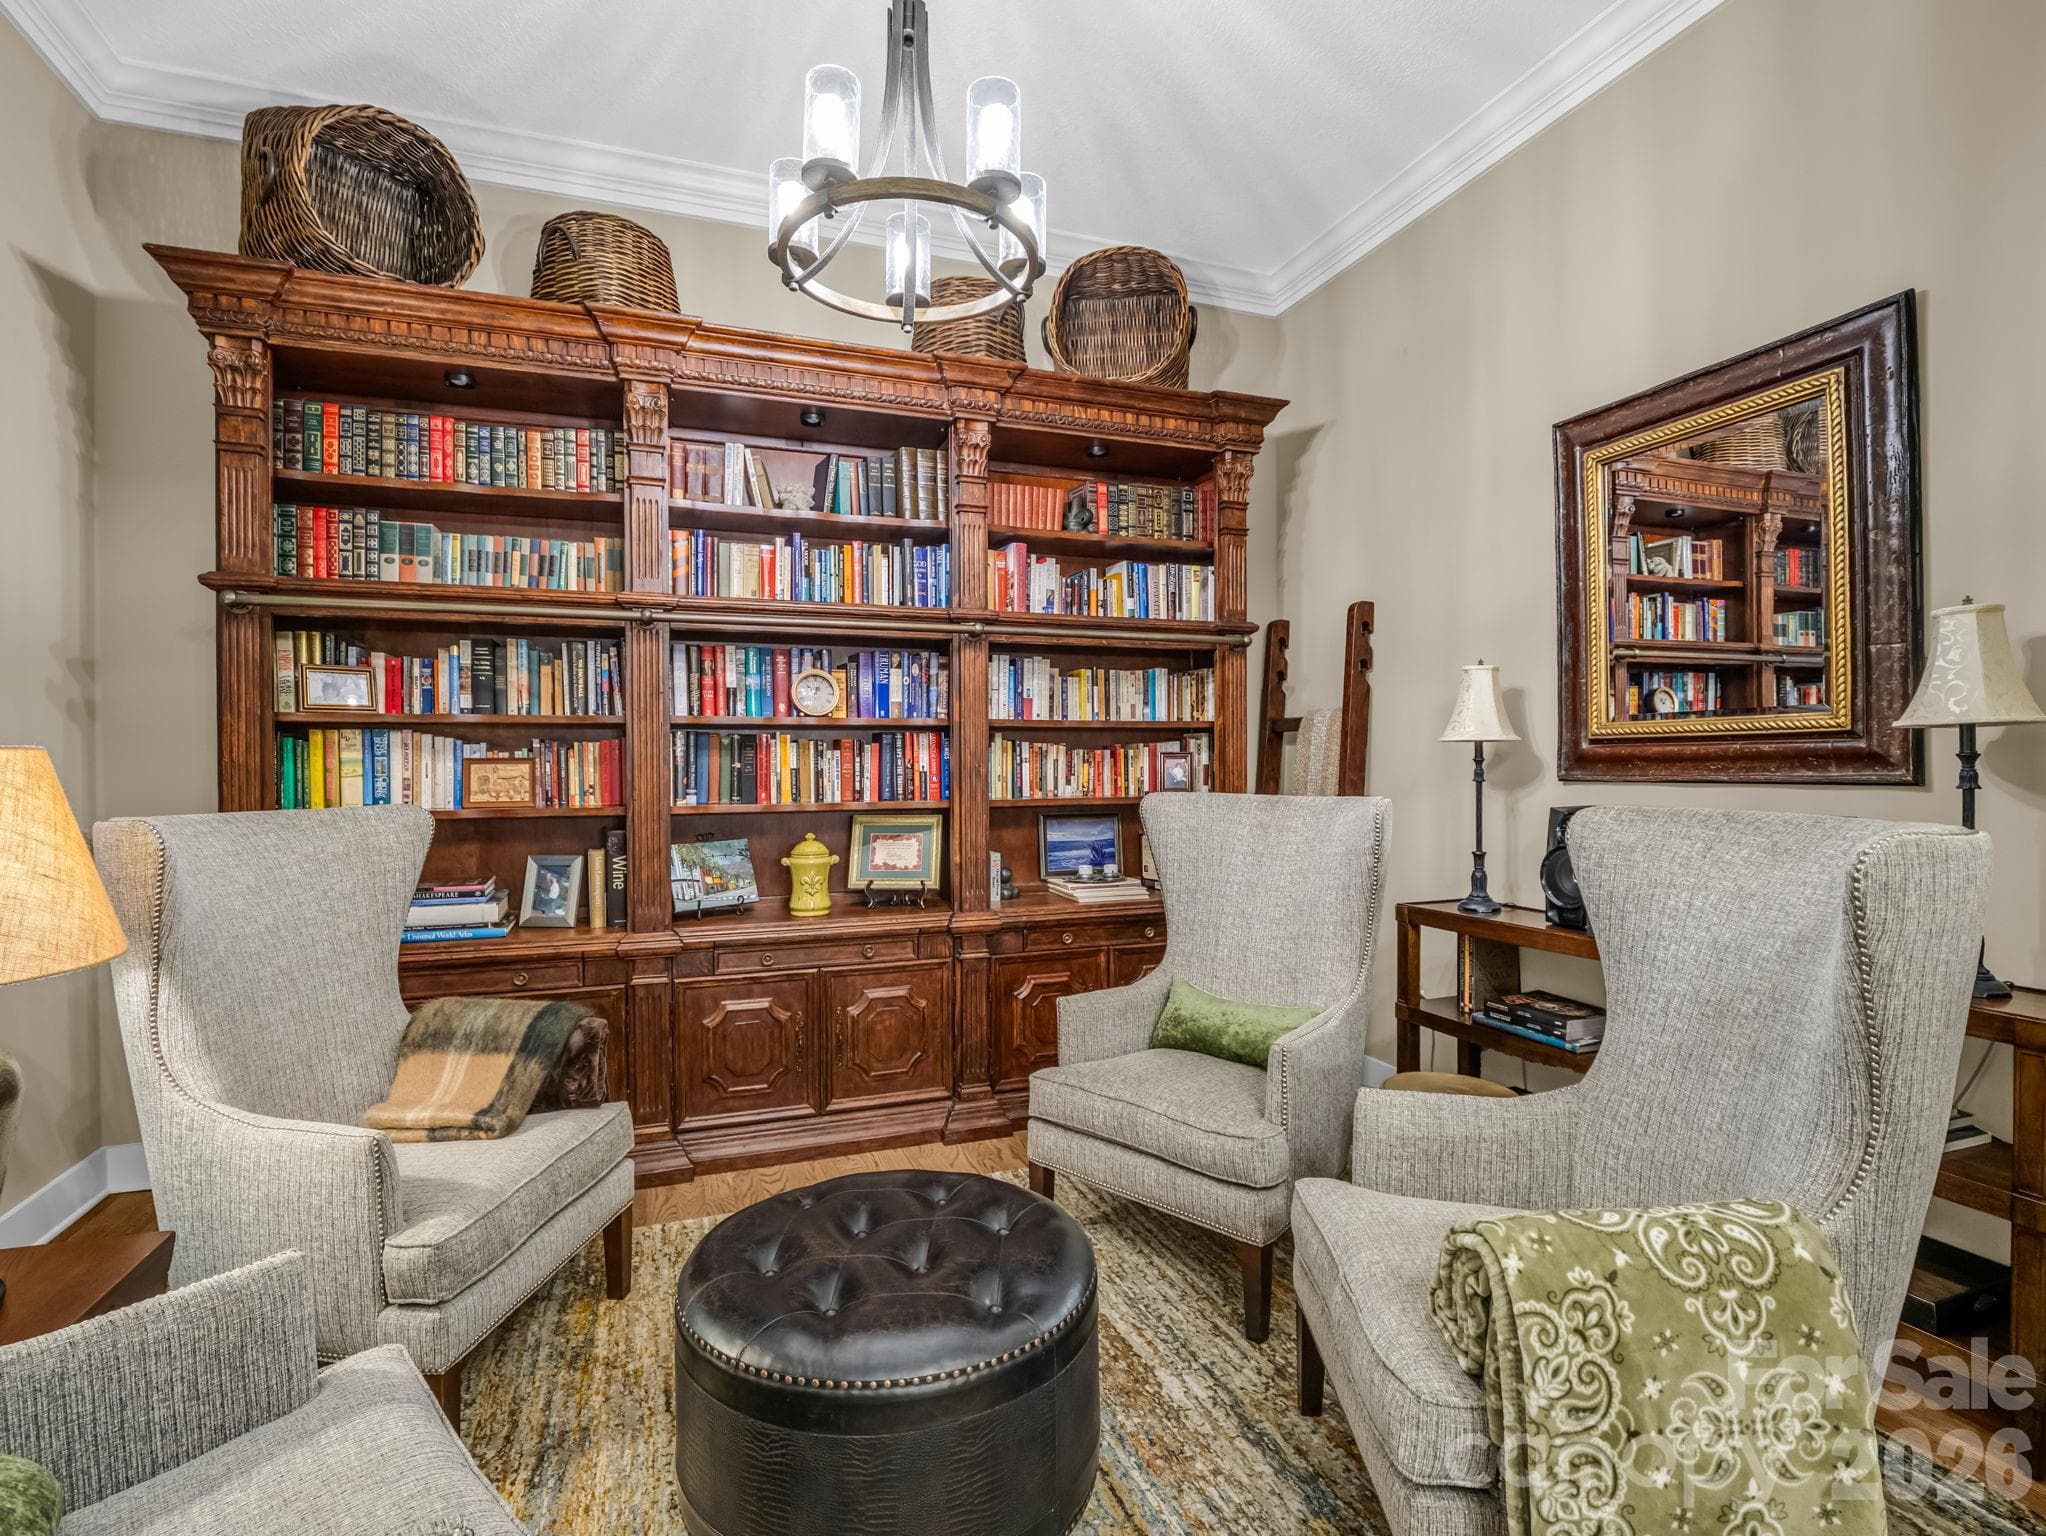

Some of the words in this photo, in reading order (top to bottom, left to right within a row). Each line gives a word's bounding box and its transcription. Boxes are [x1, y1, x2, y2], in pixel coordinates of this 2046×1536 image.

[1152, 581, 1160, 617] DISRAELI
[278, 649, 292, 672] EMPIRE
[879, 653, 889, 684] TRUMAN
[612, 855, 627, 890] Wine
[407, 932, 436, 940] Universal
[435, 931, 456, 939] World
[456, 930, 473, 938] Atlas
